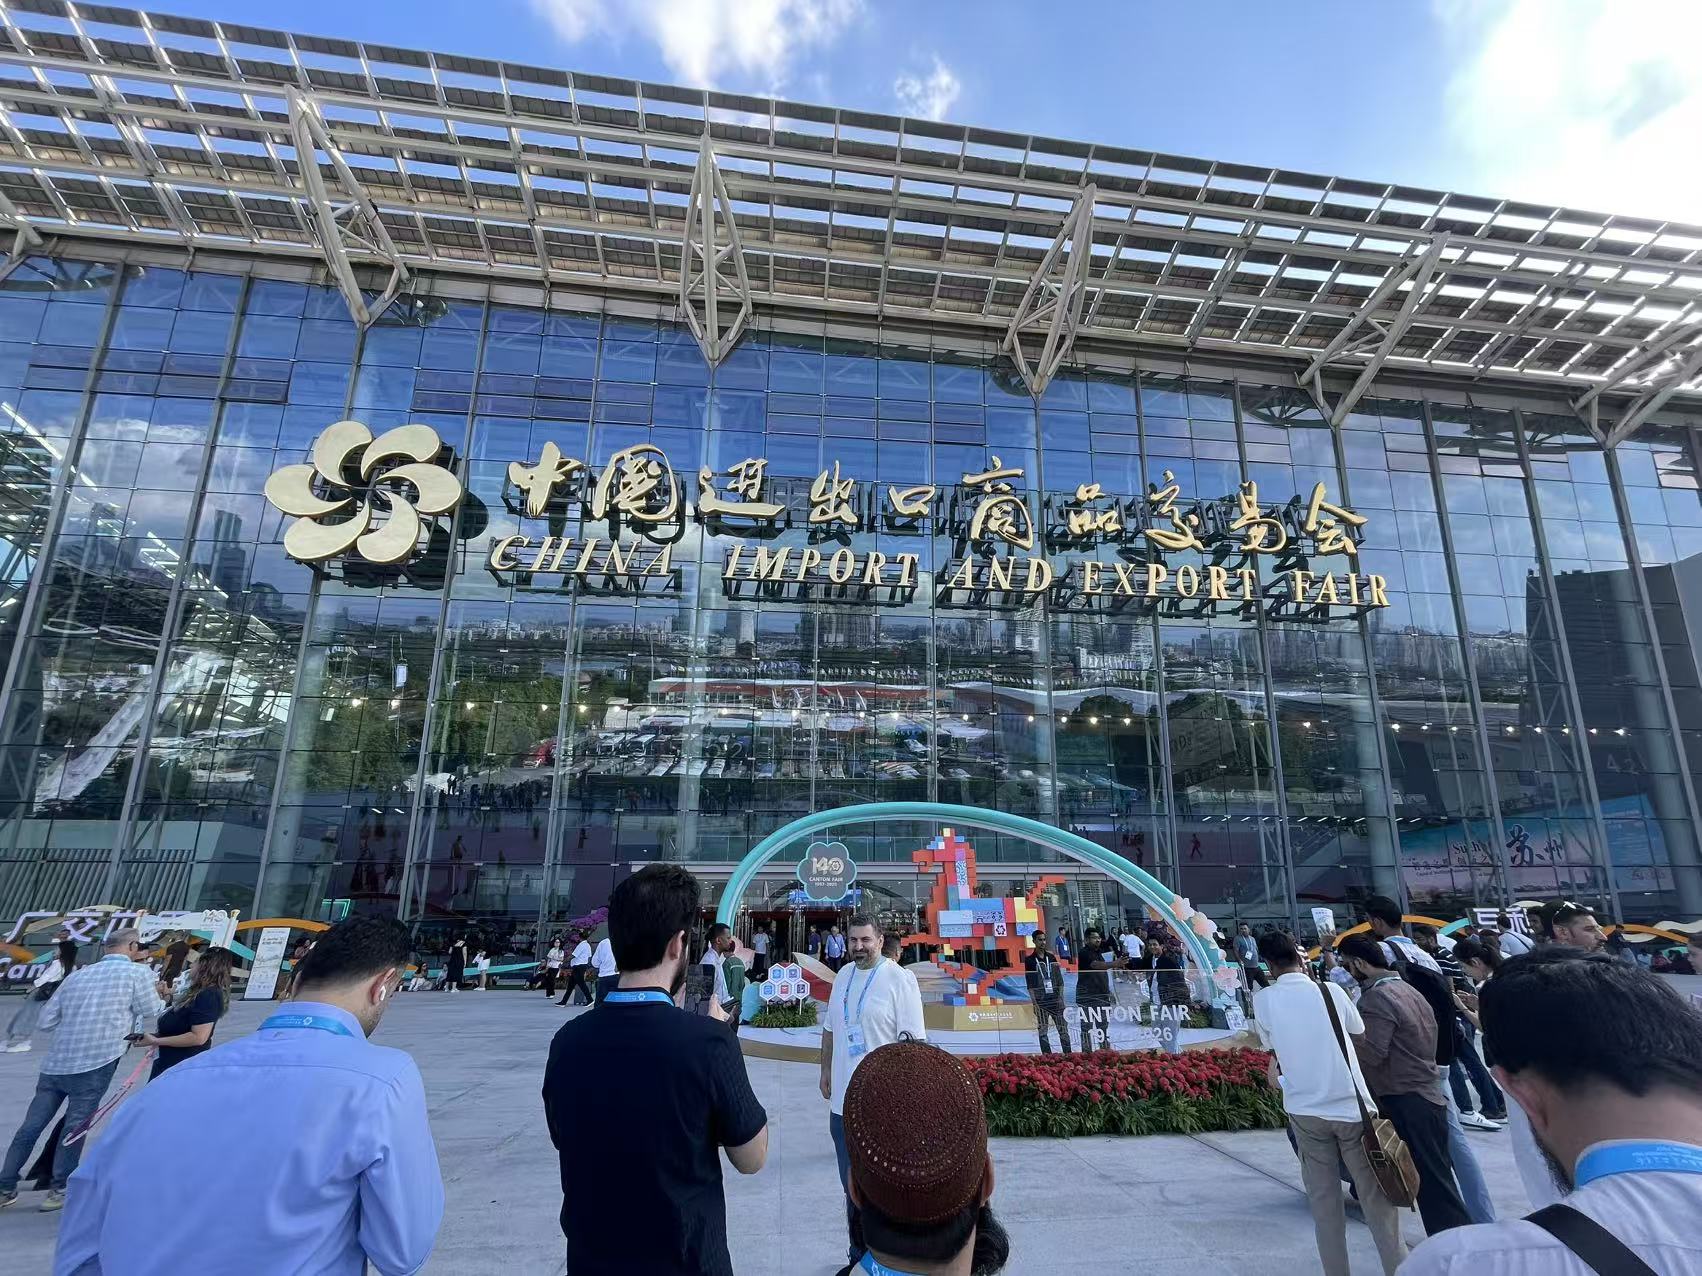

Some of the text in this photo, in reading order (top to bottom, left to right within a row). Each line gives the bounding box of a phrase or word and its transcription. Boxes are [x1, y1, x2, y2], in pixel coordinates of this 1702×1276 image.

[491, 535, 1391, 608] CHINA IMPORT AND EXPORT FAIR
[812, 857, 845, 875] 140
[1063, 1004, 1192, 1023] CANTON FAIR
